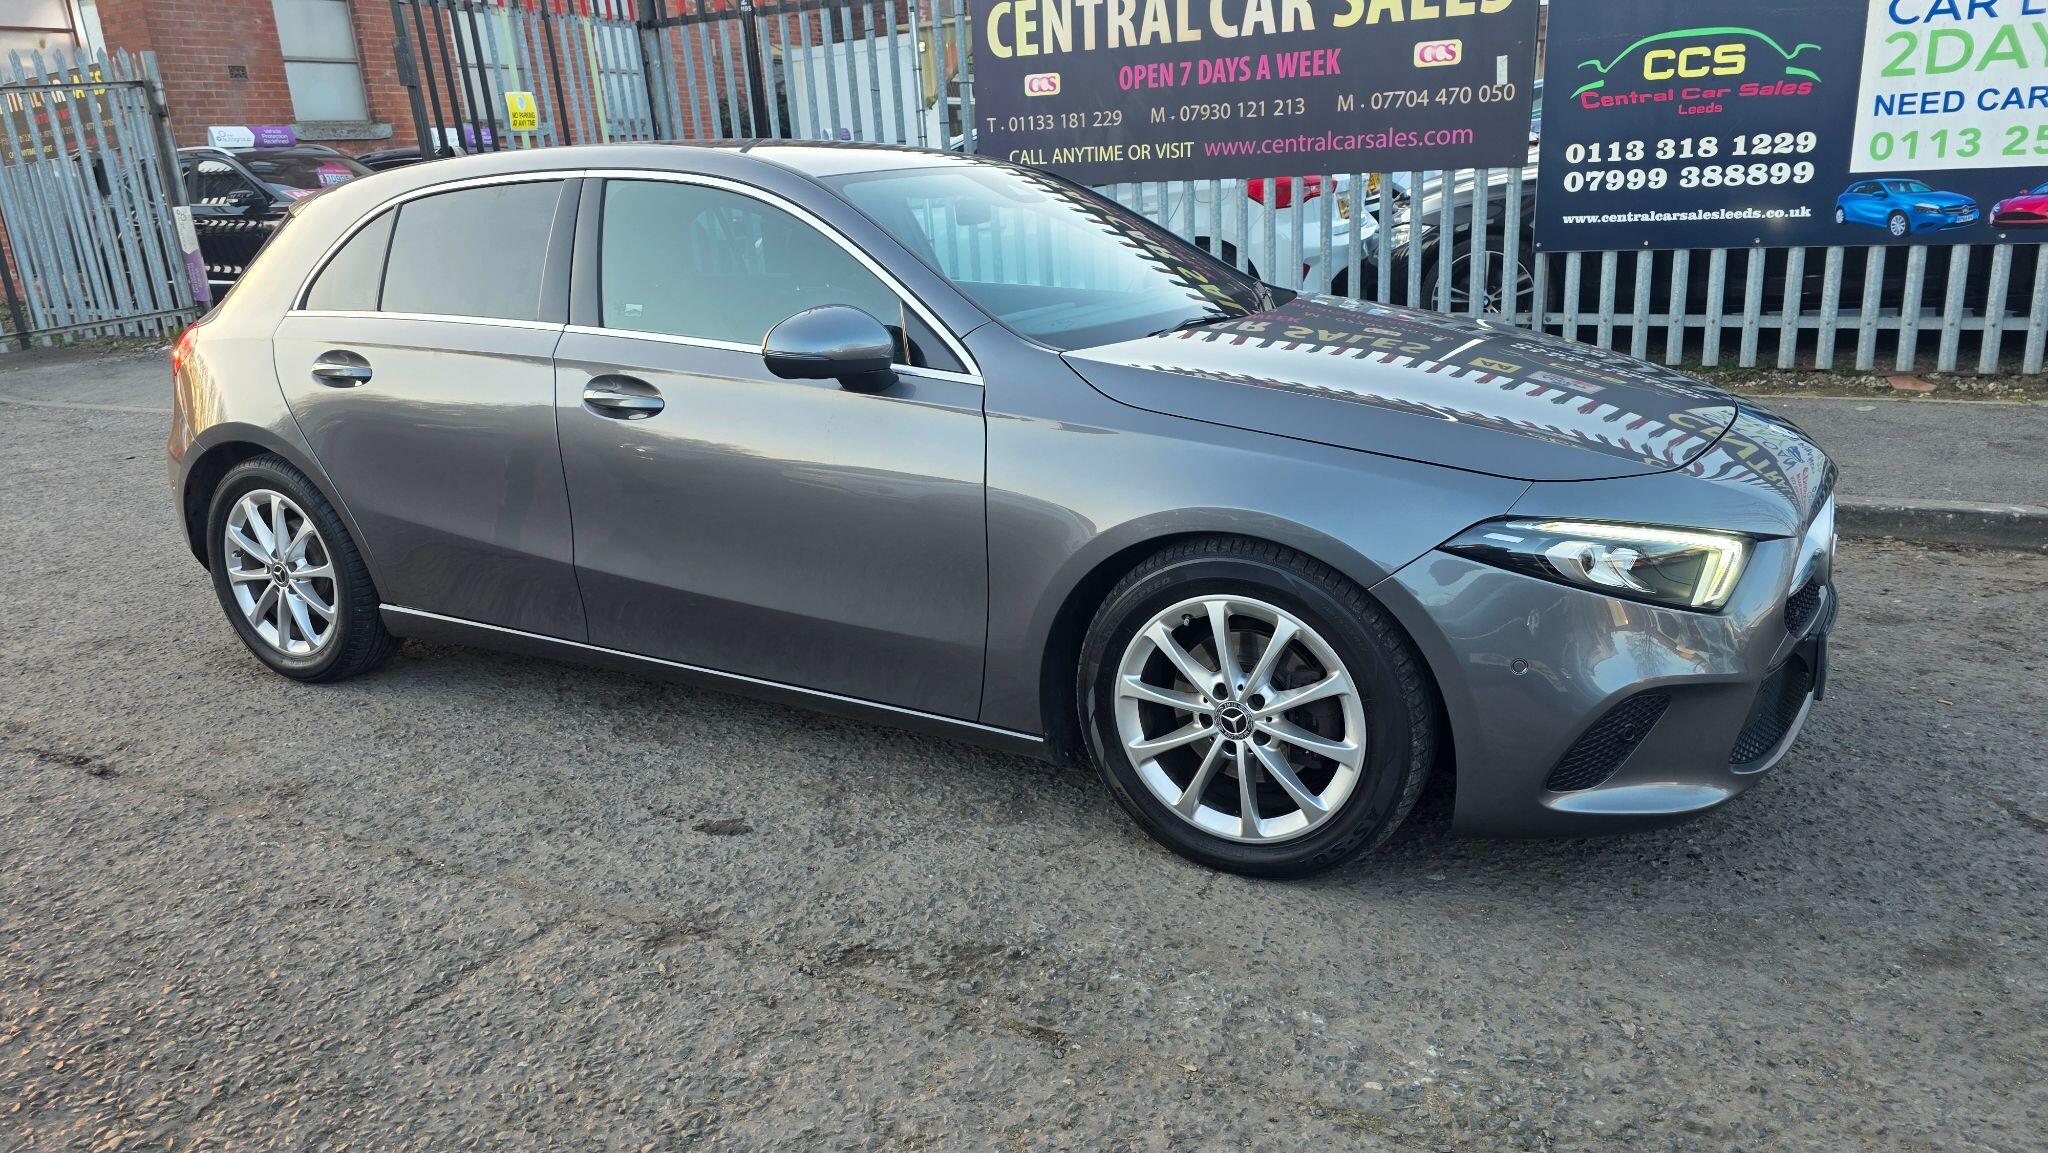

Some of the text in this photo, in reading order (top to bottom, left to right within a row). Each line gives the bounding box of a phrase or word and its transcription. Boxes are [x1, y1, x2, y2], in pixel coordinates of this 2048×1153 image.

[987, 0, 1201, 58] CENTRAL
[1210, 0, 1315, 38] CAR
[1419, 44, 1456, 63] CCS
[1643, 43, 1746, 81] CCS
[1119, 48, 1341, 91] OPEN 7 DAYS A WEEK
[1030, 77, 1057, 93] CCS
[1371, 90, 1429, 110] 07704
[1435, 86, 1472, 106] 470
[1478, 83, 1516, 103] 050
[1580, 80, 1813, 110] Central Car Sales
[1179, 102, 1231, 122] 07930
[1237, 101, 1265, 118] 121
[1273, 97, 1305, 116] 213
[1678, 103, 1723, 115] Leeds
[1873, 90, 1965, 117] NEED
[1009, 114, 1054, 132] 01133
[1061, 112, 1086, 128] 181
[1093, 110, 1123, 127] 229
[1009, 141, 1194, 165] CALL ANYTIME OR VISIT
[1204, 127, 1473, 157] www.centralcarsales.com
[1565, 131, 1817, 164] 0113 318 1229
[1869, 127, 1982, 161] 0113
[1563, 161, 1815, 193] 07999 388899
[1562, 206, 1812, 224] www.centralcarsalesleeds.co.uk
